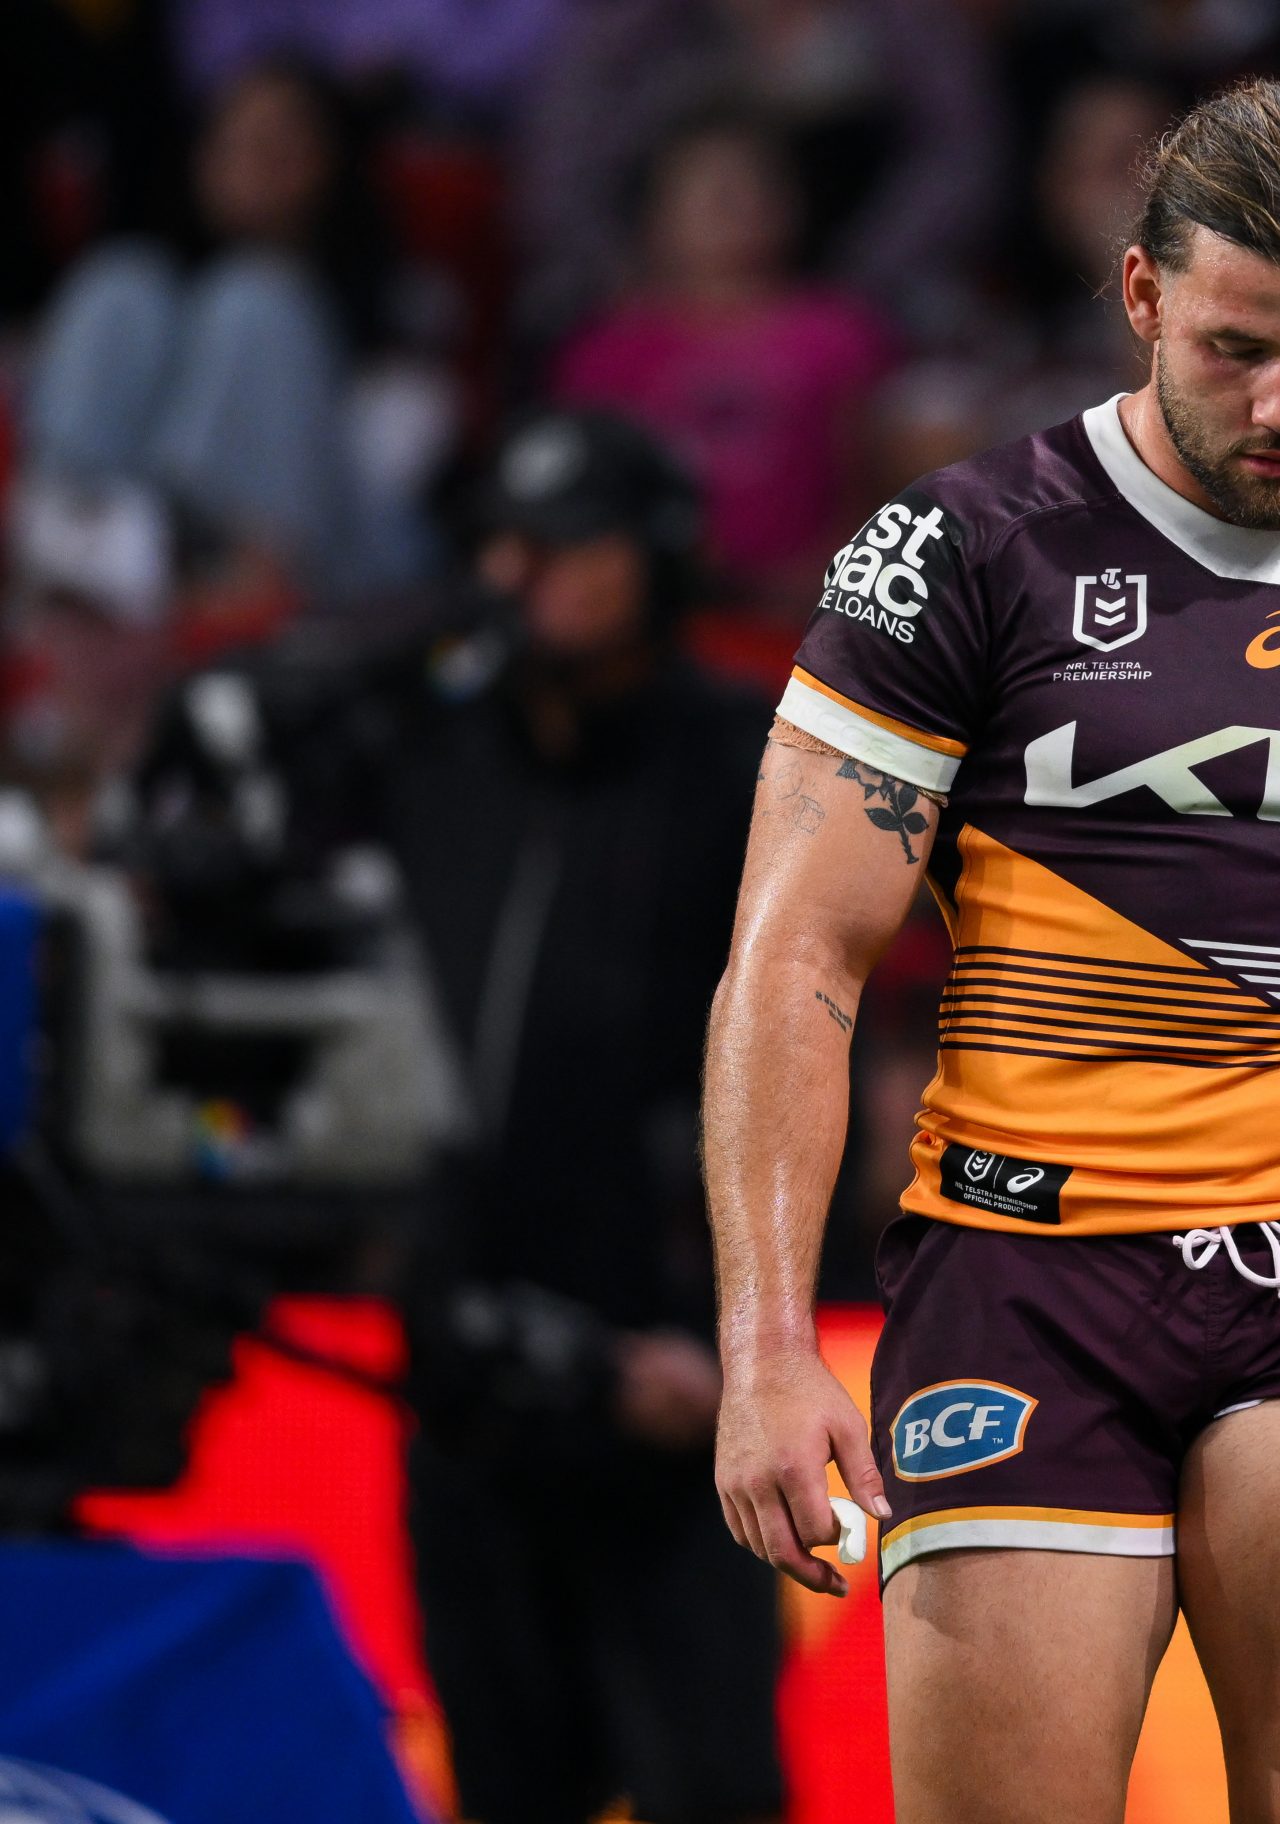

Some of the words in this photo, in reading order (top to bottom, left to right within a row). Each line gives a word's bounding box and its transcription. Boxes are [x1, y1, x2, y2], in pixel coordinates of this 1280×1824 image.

[851, 503, 943, 569] st
[834, 594, 917, 645] LOANS
[1053, 670, 1153, 682] PREMIERSHIP
[1066, 662, 1088, 670] NRL
[1092, 662, 1142, 670] TELSTRA
[963, 1193, 993, 1206] OFFICIAL
[993, 1201, 1025, 1214] PRODUCT
[965, 1185, 993, 1198] TELSTRA
[993, 1193, 1039, 1212] PREMIERSHIP
[902, 1402, 1005, 1459] BCF
